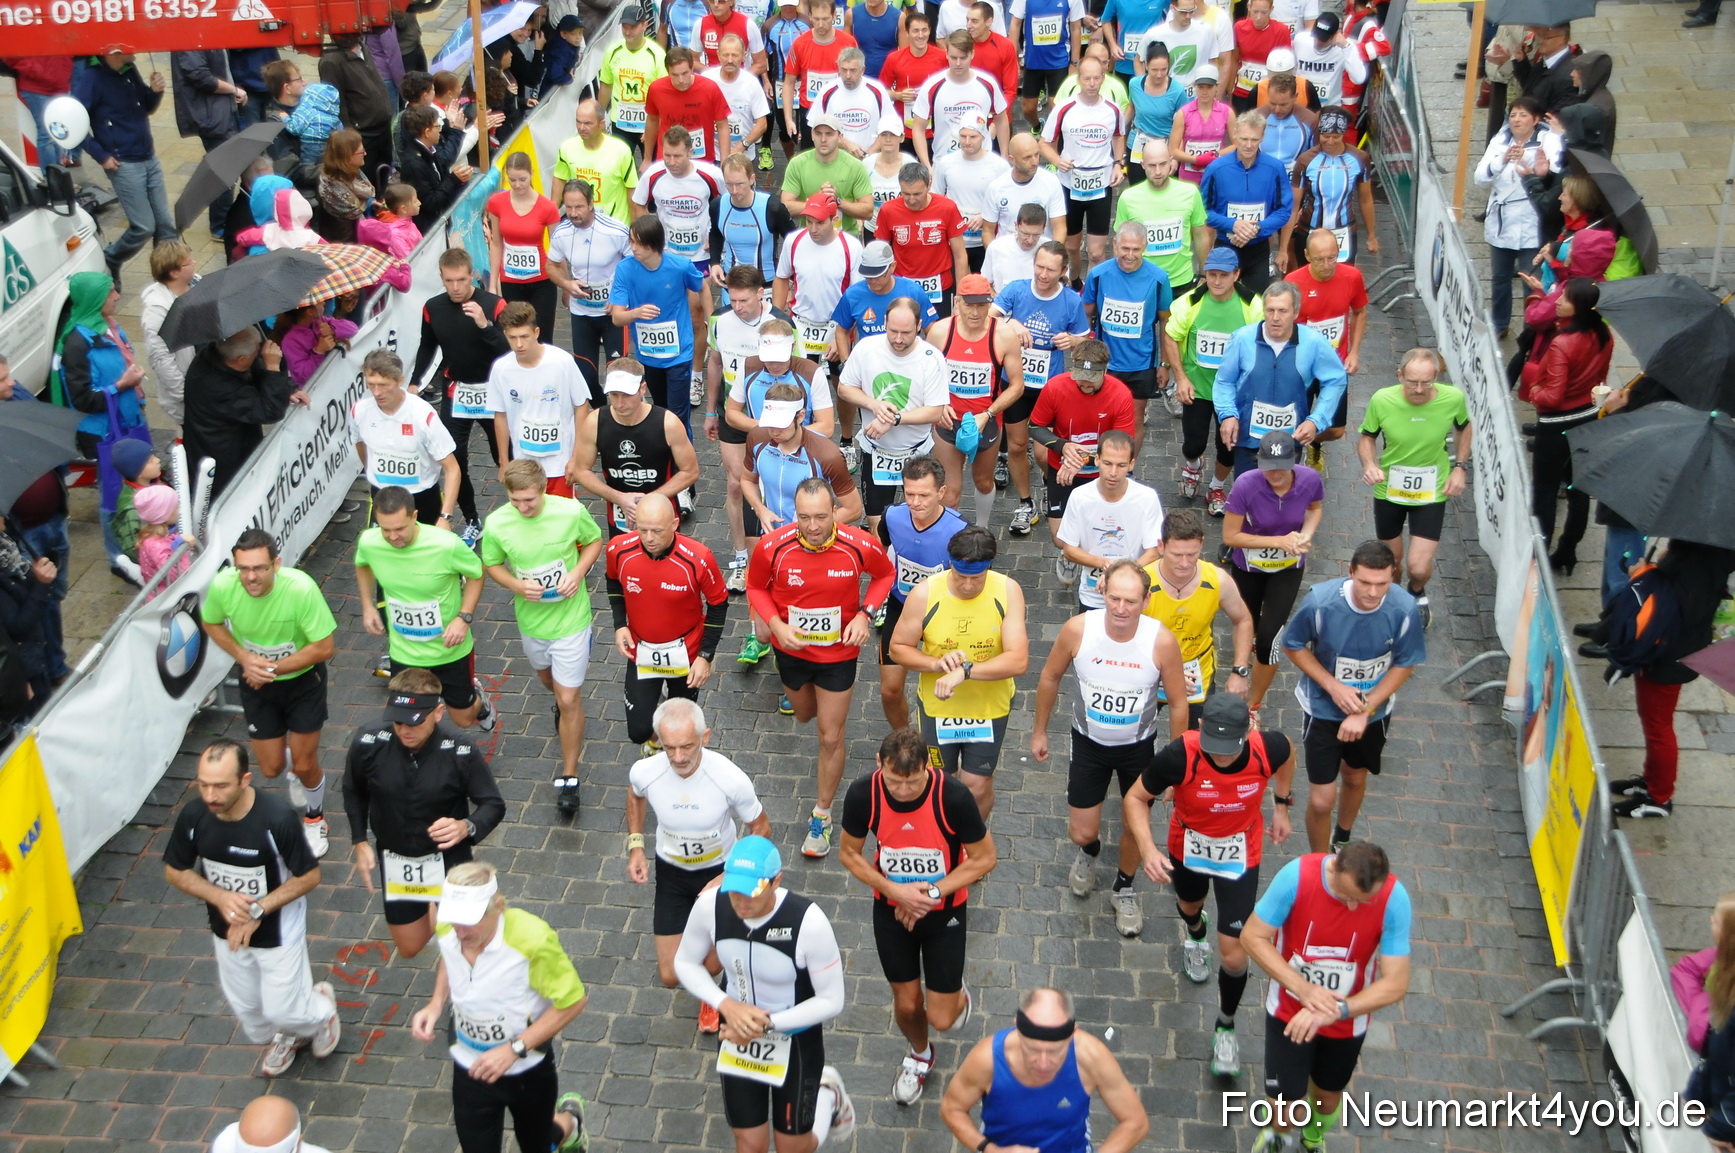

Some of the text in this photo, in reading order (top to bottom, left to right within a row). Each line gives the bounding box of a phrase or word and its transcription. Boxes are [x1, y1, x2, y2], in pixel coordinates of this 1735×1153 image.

[52, 0, 136, 24] 09181
[146, 0, 217, 20] 6352
[1038, 24, 1057, 34] 309
[619, 67, 645, 76] Müller
[1299, 60, 1334, 72] THULE
[1244, 70, 1261, 81] 473
[626, 83, 638, 95] M
[943, 105, 975, 113] GERHART
[620, 109, 646, 122] 2070
[576, 168, 602, 176] Müller
[1074, 178, 1102, 190] 3025
[661, 198, 695, 206] GERHART
[669, 231, 699, 244] 2956
[1148, 227, 1180, 242] 3047
[1155, 243, 1175, 251] Norbert
[507, 254, 536, 267] 2989
[1105, 308, 1138, 325] 2553
[803, 328, 828, 341] 497
[1110, 325, 1130, 334] Ludwig
[641, 332, 674, 344] 2990
[950, 370, 986, 385] 2612
[955, 387, 980, 395] Manfred
[1255, 411, 1292, 428] 3052
[523, 426, 558, 442] 3059
[1270, 443, 1281, 456] NY
[377, 458, 416, 475] 3060
[1402, 476, 1422, 490] 50
[827, 568, 854, 578] Markus
[660, 582, 687, 592] Robert
[394, 609, 436, 627] 2913
[798, 617, 832, 632] 228
[402, 627, 432, 637] Christian
[652, 651, 670, 667] 91
[1105, 660, 1143, 669] KLEBL
[652, 667, 675, 675] Robert
[1091, 692, 1138, 713] 2697
[1099, 715, 1125, 724] Roland
[954, 730, 976, 738] Alfred
[680, 842, 704, 856] 13
[1190, 840, 1240, 861] 3172
[684, 857, 703, 865] Willi
[886, 857, 939, 874] 2868
[403, 864, 424, 883] 81
[404, 885, 428, 894] Ralph
